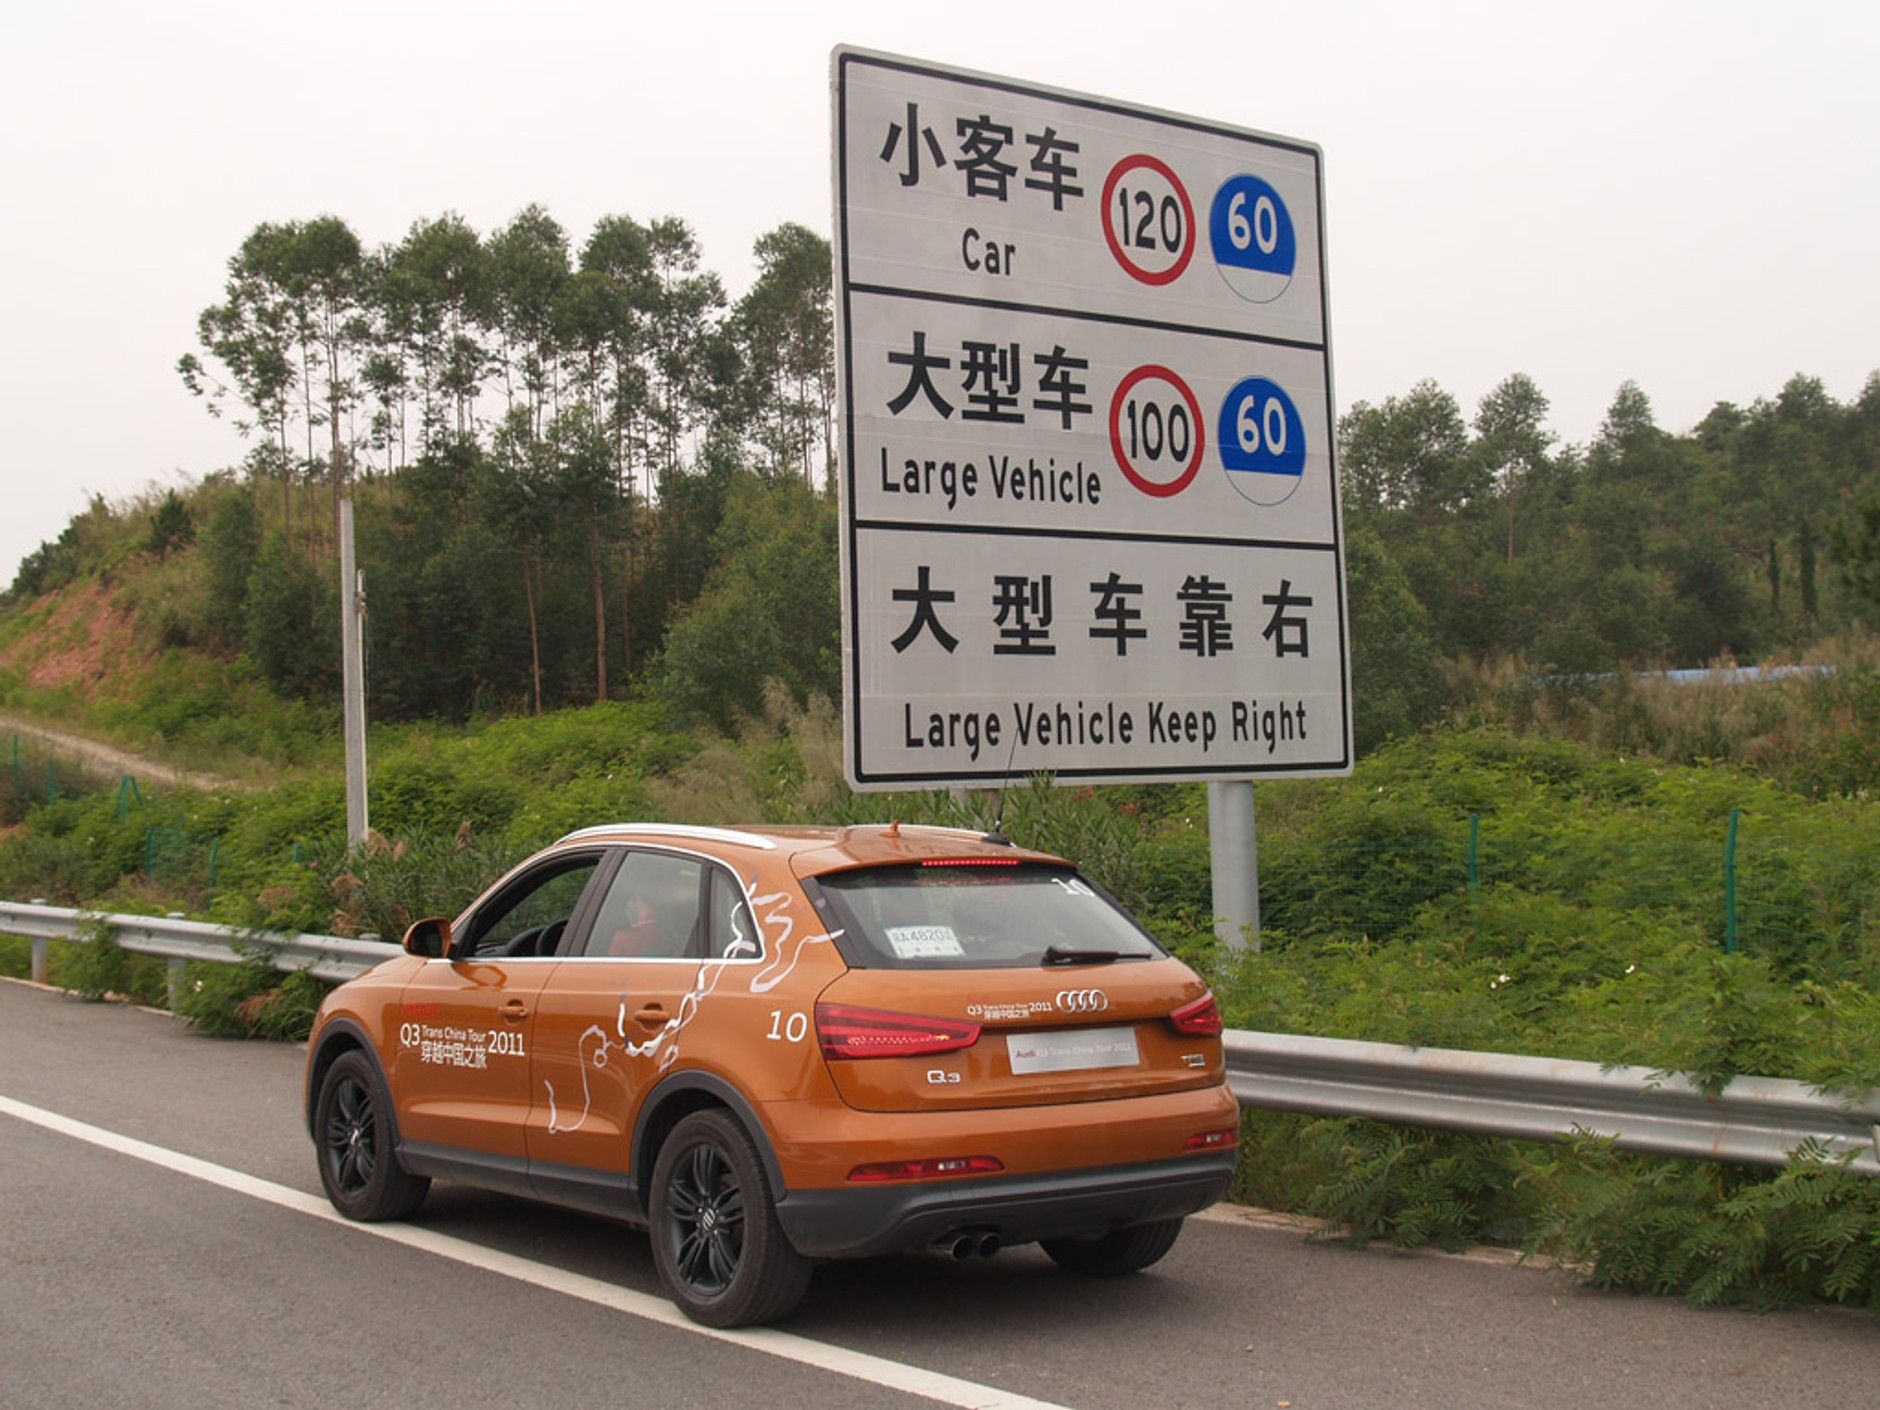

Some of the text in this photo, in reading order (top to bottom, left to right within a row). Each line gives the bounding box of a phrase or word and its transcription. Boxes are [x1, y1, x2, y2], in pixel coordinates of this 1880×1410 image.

[879, 102, 1084, 212] 小客车
[1118, 186, 1183, 254] 120
[1227, 191, 1278, 255] 60
[962, 227, 1016, 277] Car
[886, 331, 1093, 431] 大型车
[1126, 398, 1190, 464] 100
[1236, 394, 1287, 457] 60
[881, 446, 1102, 511] Large Vehicle
[890, 565, 1313, 659] 大型车靠右
[904, 699, 1308, 762] Large Vehicle Keep Right
[765, 1008, 809, 1043] 10
[1029, 1001, 1053, 1013] 2011
[400, 1022, 526, 1057] Q3 Trans China Tour 2011
[1015, 1049, 1036, 1059] Audi
[926, 1069, 961, 1084] Q3
